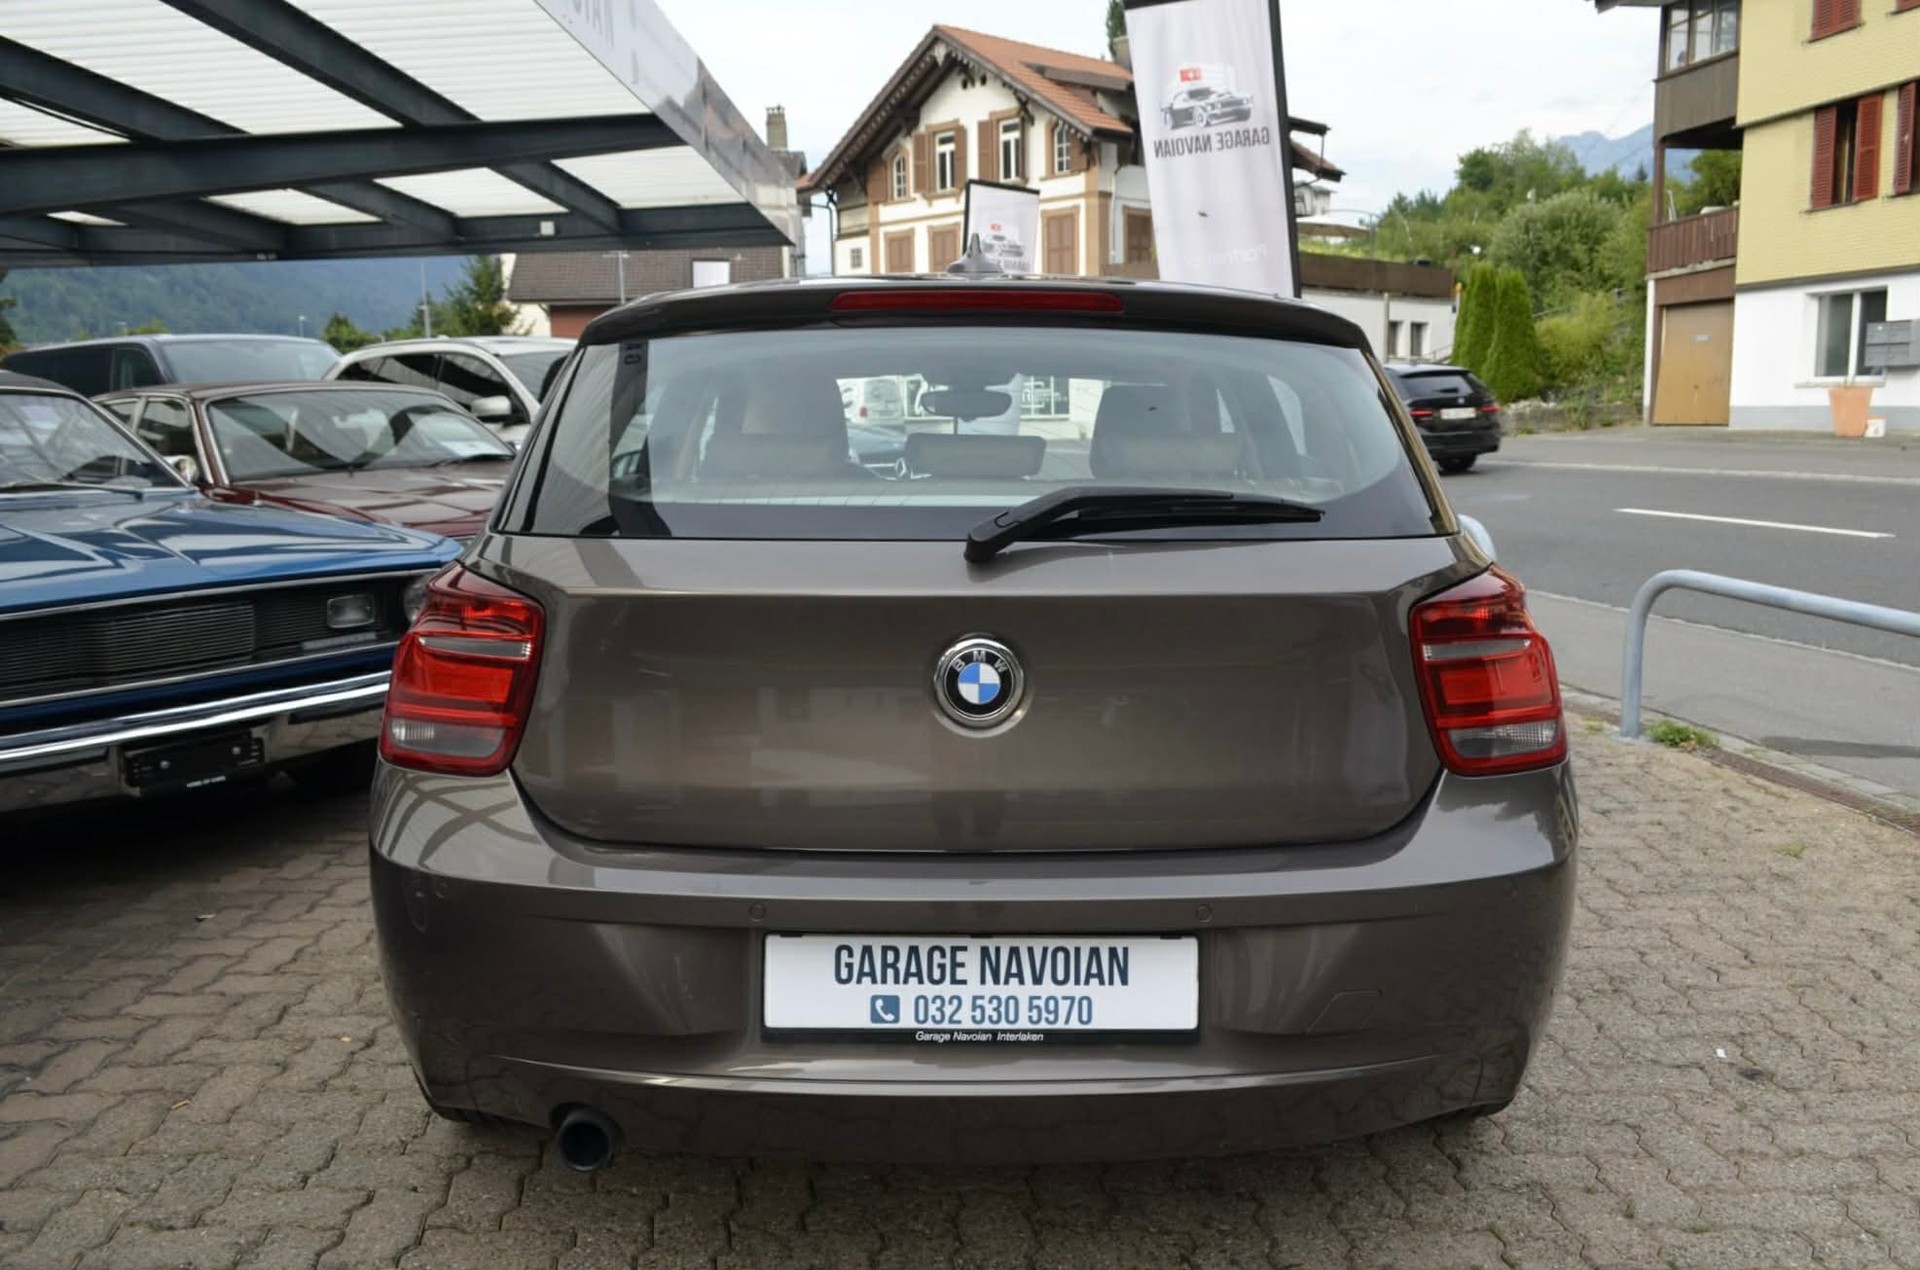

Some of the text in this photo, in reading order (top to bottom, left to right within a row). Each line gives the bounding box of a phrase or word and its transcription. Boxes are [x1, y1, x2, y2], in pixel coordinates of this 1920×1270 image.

[952, 650, 1008, 673] BMW
[834, 944, 1129, 987] GARAGE NAVOIAN
[914, 995, 1093, 1025] 032 530 5970
[915, 1030, 1044, 1043] Garage Navoian Interlaken
